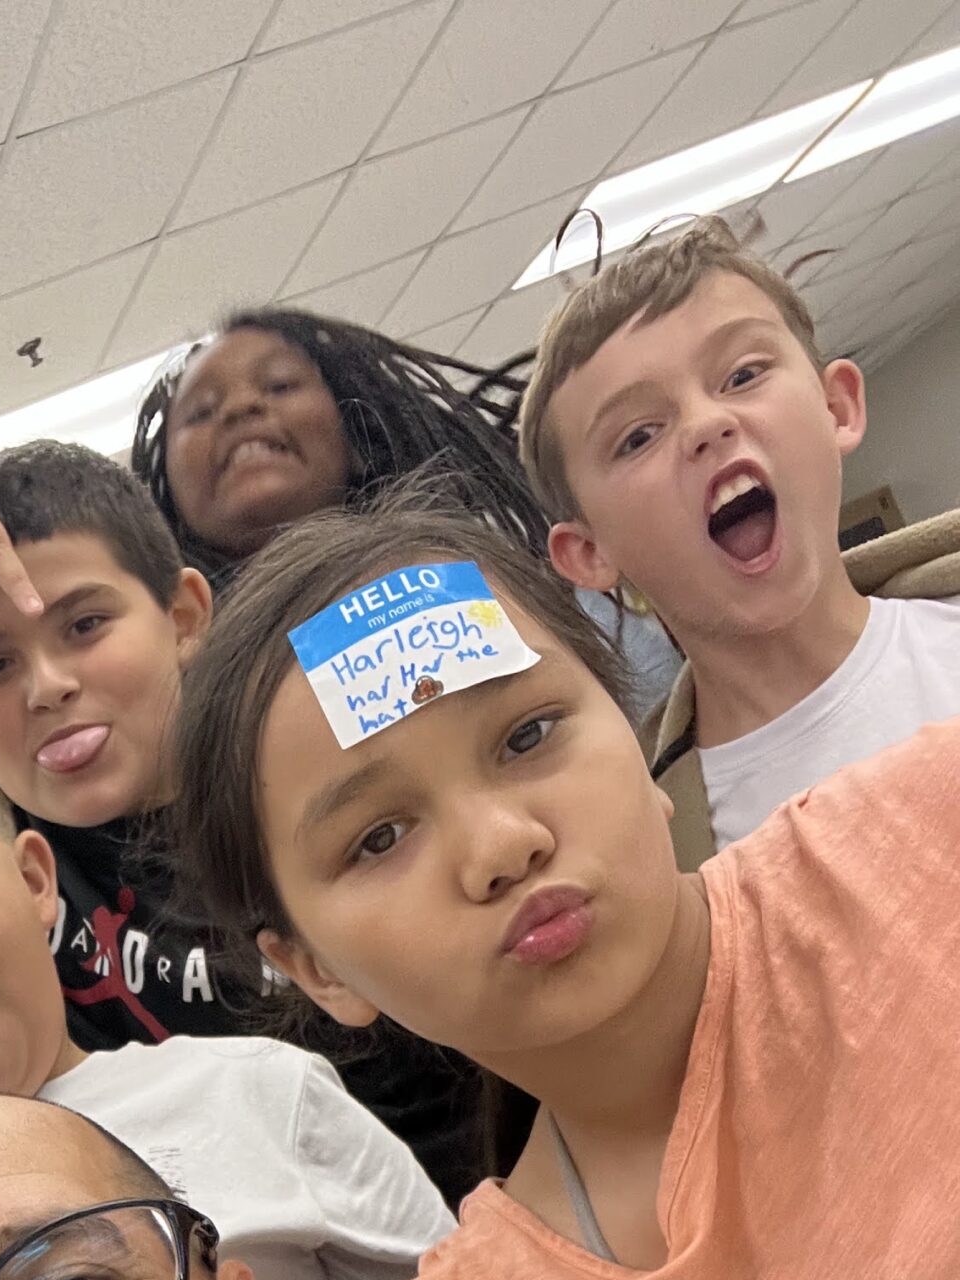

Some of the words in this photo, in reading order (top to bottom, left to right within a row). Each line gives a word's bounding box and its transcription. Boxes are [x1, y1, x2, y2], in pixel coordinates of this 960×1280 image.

[339, 568, 440, 624] HELLO
[367, 614, 387, 629] my
[389, 599, 423, 619] name
[423, 593, 435, 606] is
[331, 611, 482, 685] Harleigh
[456, 643, 499, 663] the
[358, 698, 407, 734] hat
